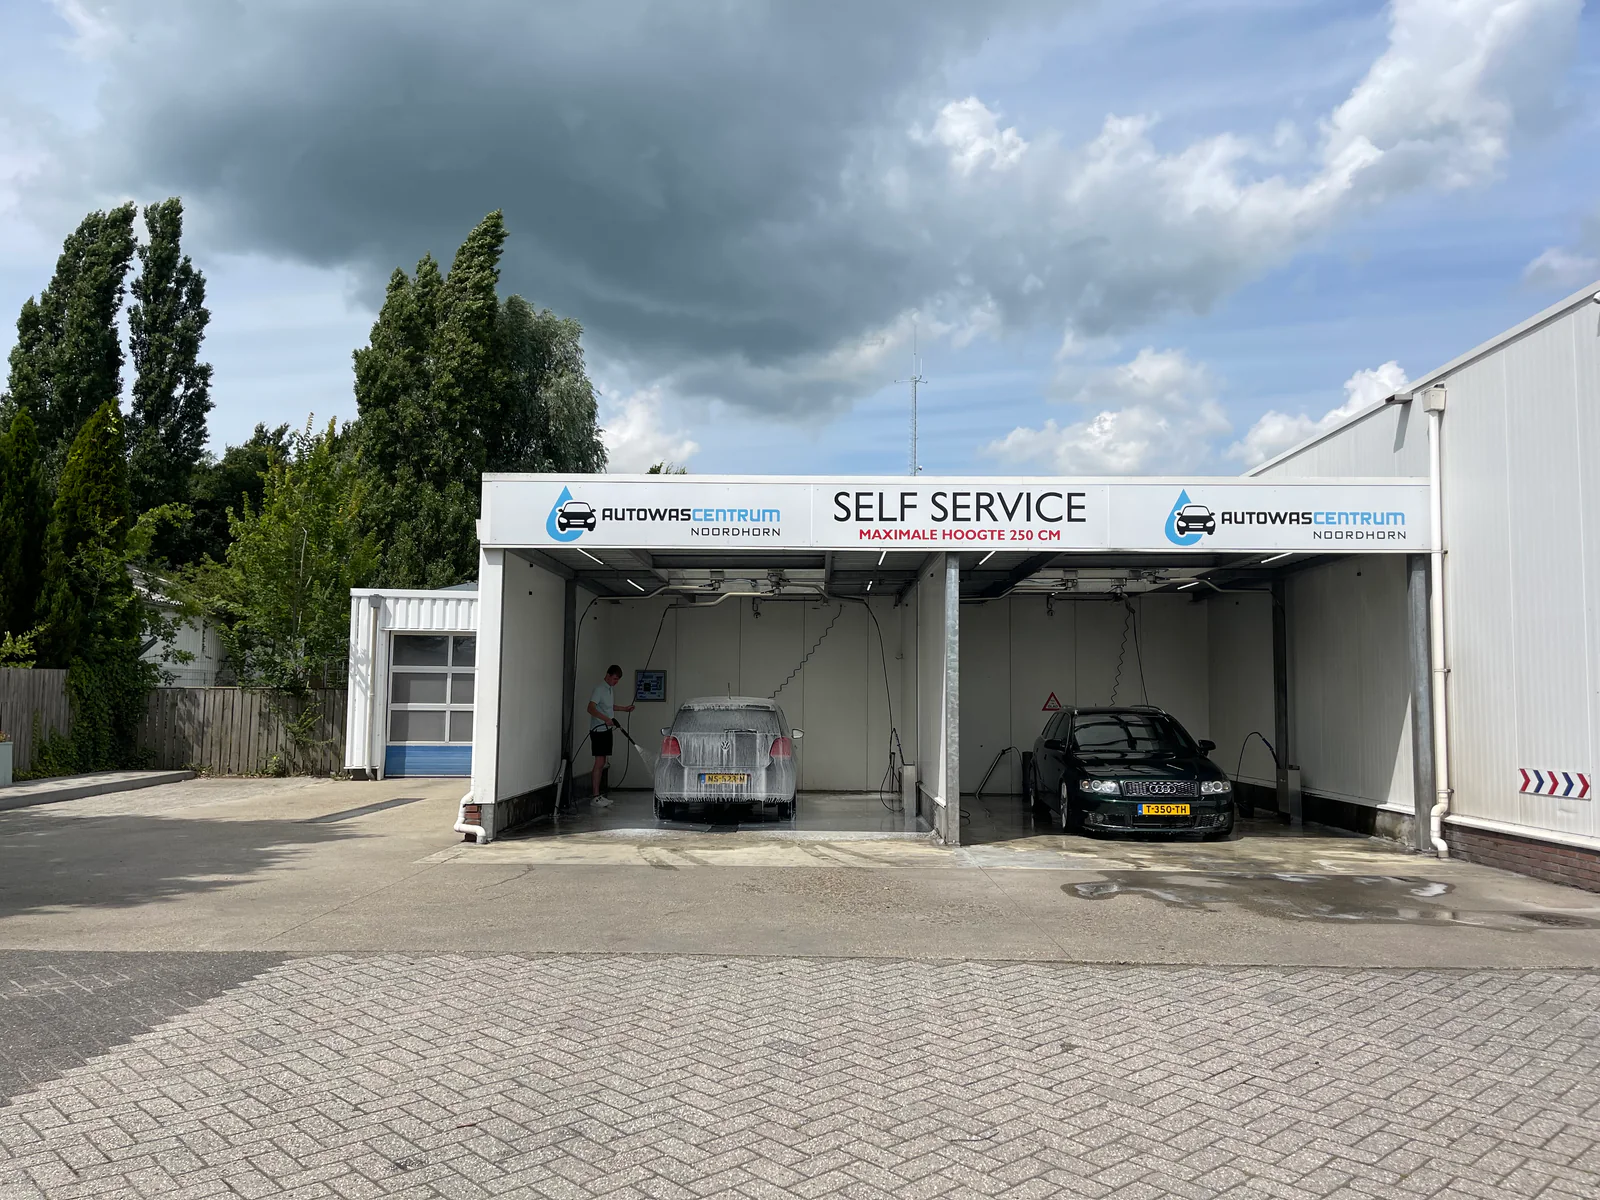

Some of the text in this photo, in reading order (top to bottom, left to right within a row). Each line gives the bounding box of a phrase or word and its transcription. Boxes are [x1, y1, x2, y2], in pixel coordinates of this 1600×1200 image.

[833, 491, 1087, 523] SELF SERVICE
[601, 508, 780, 522] AUTOWASCENTRUM
[1221, 511, 1406, 525] AUTOWASCENTRUM
[690, 527, 781, 537] NOORDHORN
[859, 529, 1061, 541] MAXIMALE HOOGTE 250 CM
[1313, 530, 1407, 540] NOORDHORN
[1146, 805, 1187, 814] T-350-TH
